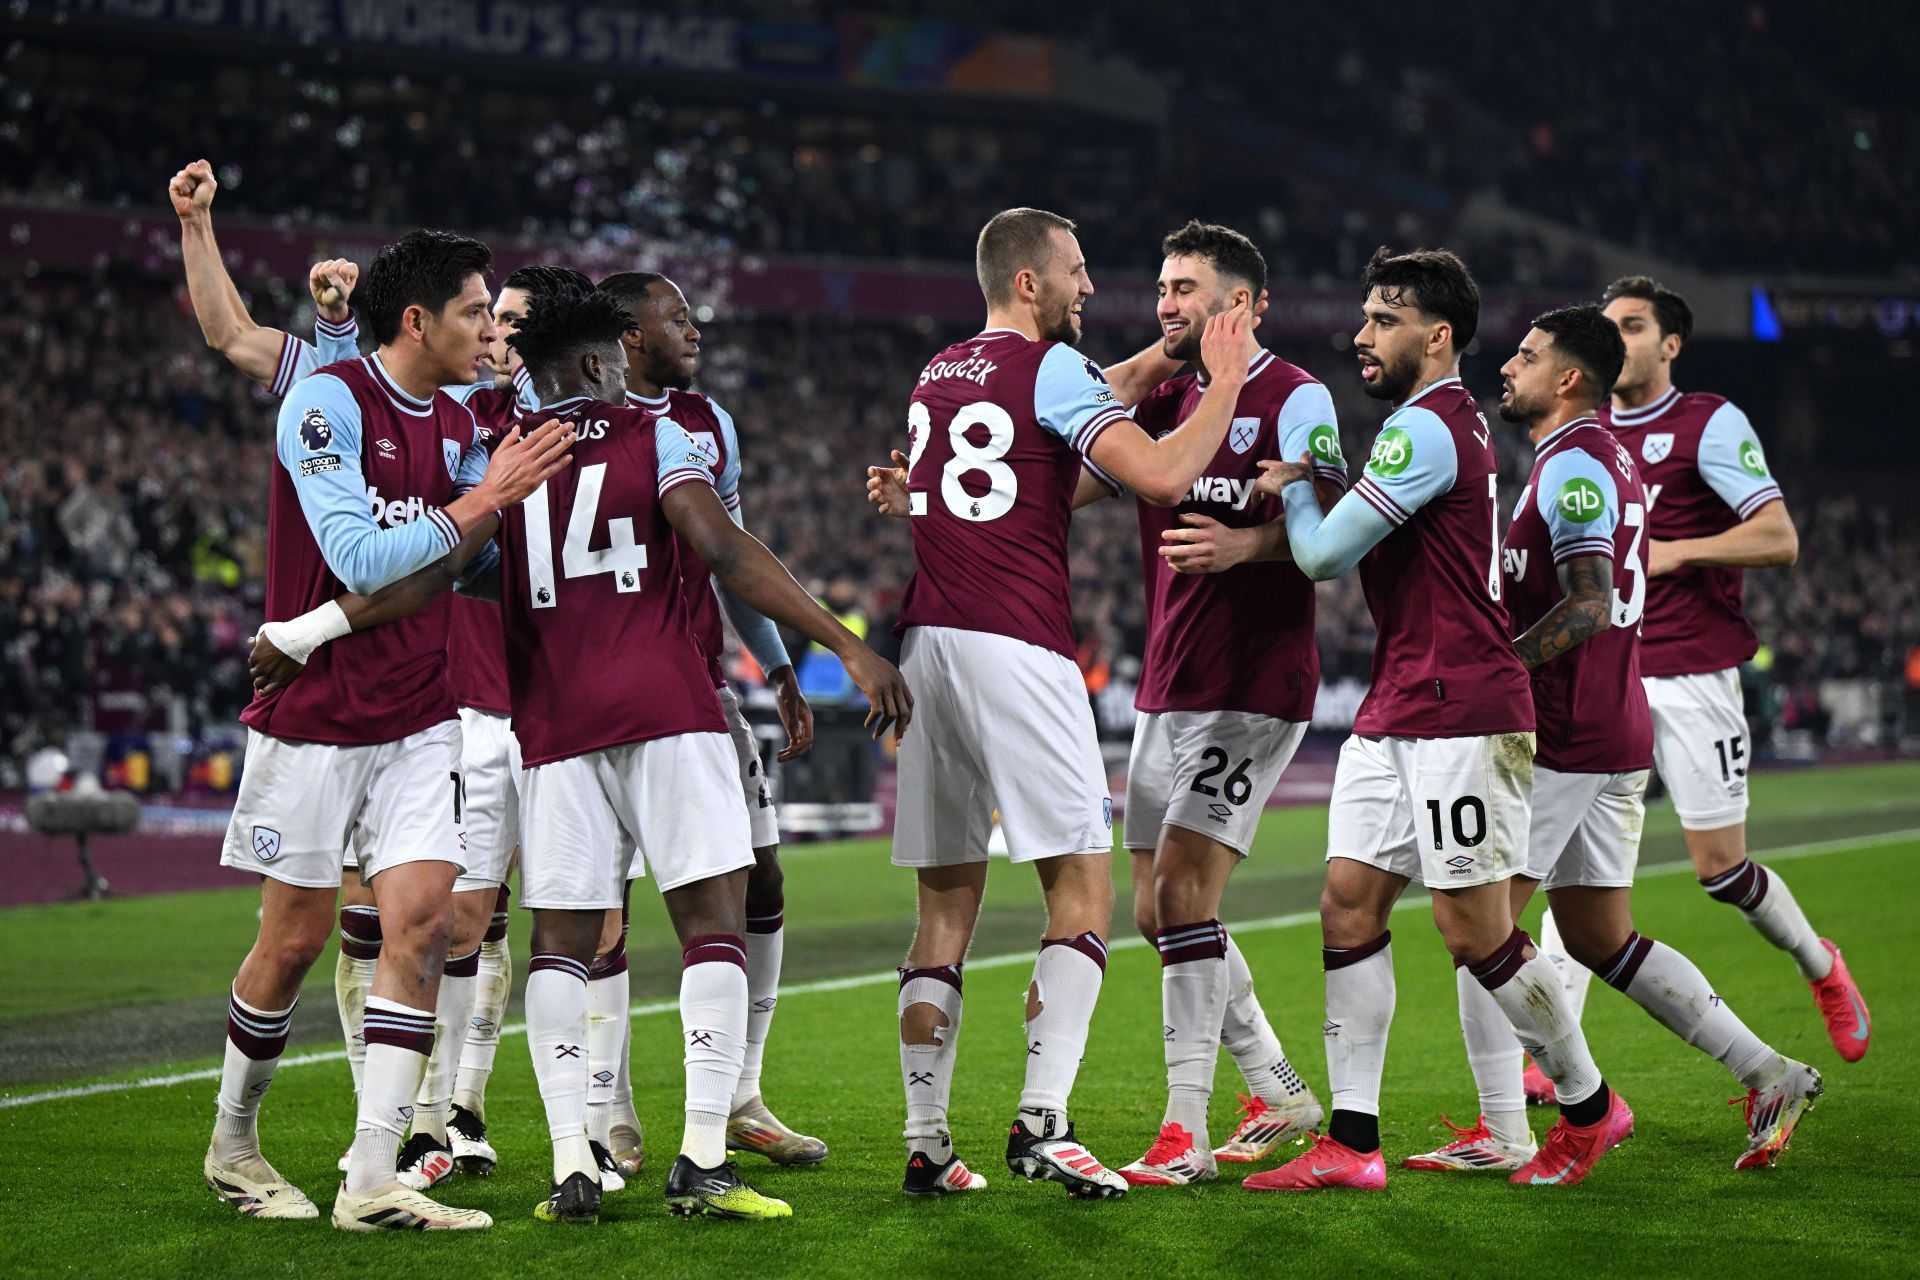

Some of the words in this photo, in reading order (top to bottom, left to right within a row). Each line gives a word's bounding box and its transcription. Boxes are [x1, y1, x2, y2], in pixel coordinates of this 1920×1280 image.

[343, 0, 572, 58] WORLD'S
[577, 6, 741, 69] STAGE
[299, 460, 312, 469] No
[312, 456, 336, 467] room
[314, 463, 342, 474] racism
[905, 401, 1018, 522] 28
[1183, 476, 1257, 511] way
[1563, 484, 1600, 516] qb
[521, 462, 648, 609] 14
[1488, 473, 1501, 601] 1
[1611, 503, 1645, 628] 3
[1190, 746, 1253, 805] 26
[1714, 736, 1745, 781] 15
[450, 771, 467, 825] 1
[1208, 813, 1227, 825] umbro
[1427, 795, 1487, 851] 10
